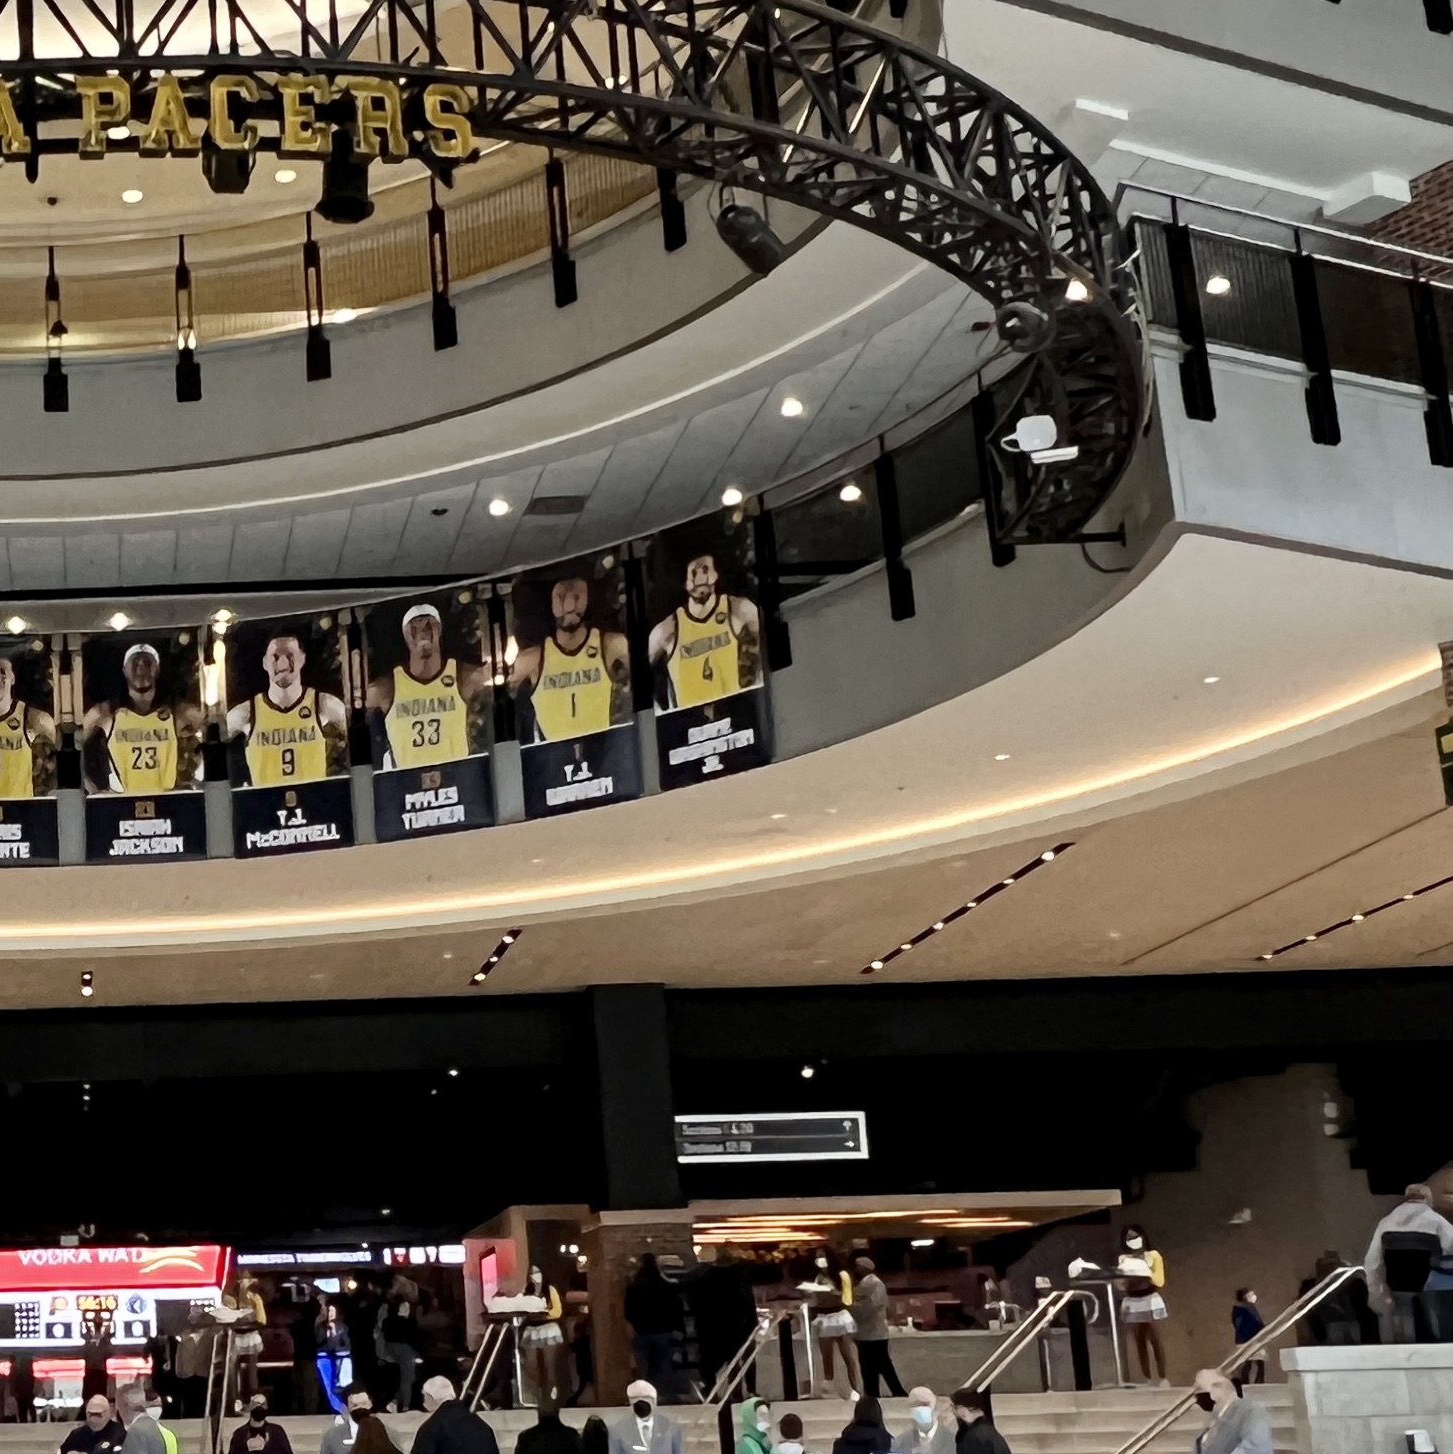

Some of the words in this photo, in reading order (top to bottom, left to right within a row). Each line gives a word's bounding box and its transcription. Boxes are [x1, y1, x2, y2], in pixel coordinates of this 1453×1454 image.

[77, 72, 482, 160] PACERS
[396, 696, 456, 719] INDIANA
[257, 725, 316, 747] INDIANA
[411, 718, 441, 748] 33
[131, 745, 157, 771] 23
[281, 748, 295, 777] 9
[18, 1248, 93, 1266] VODKA
